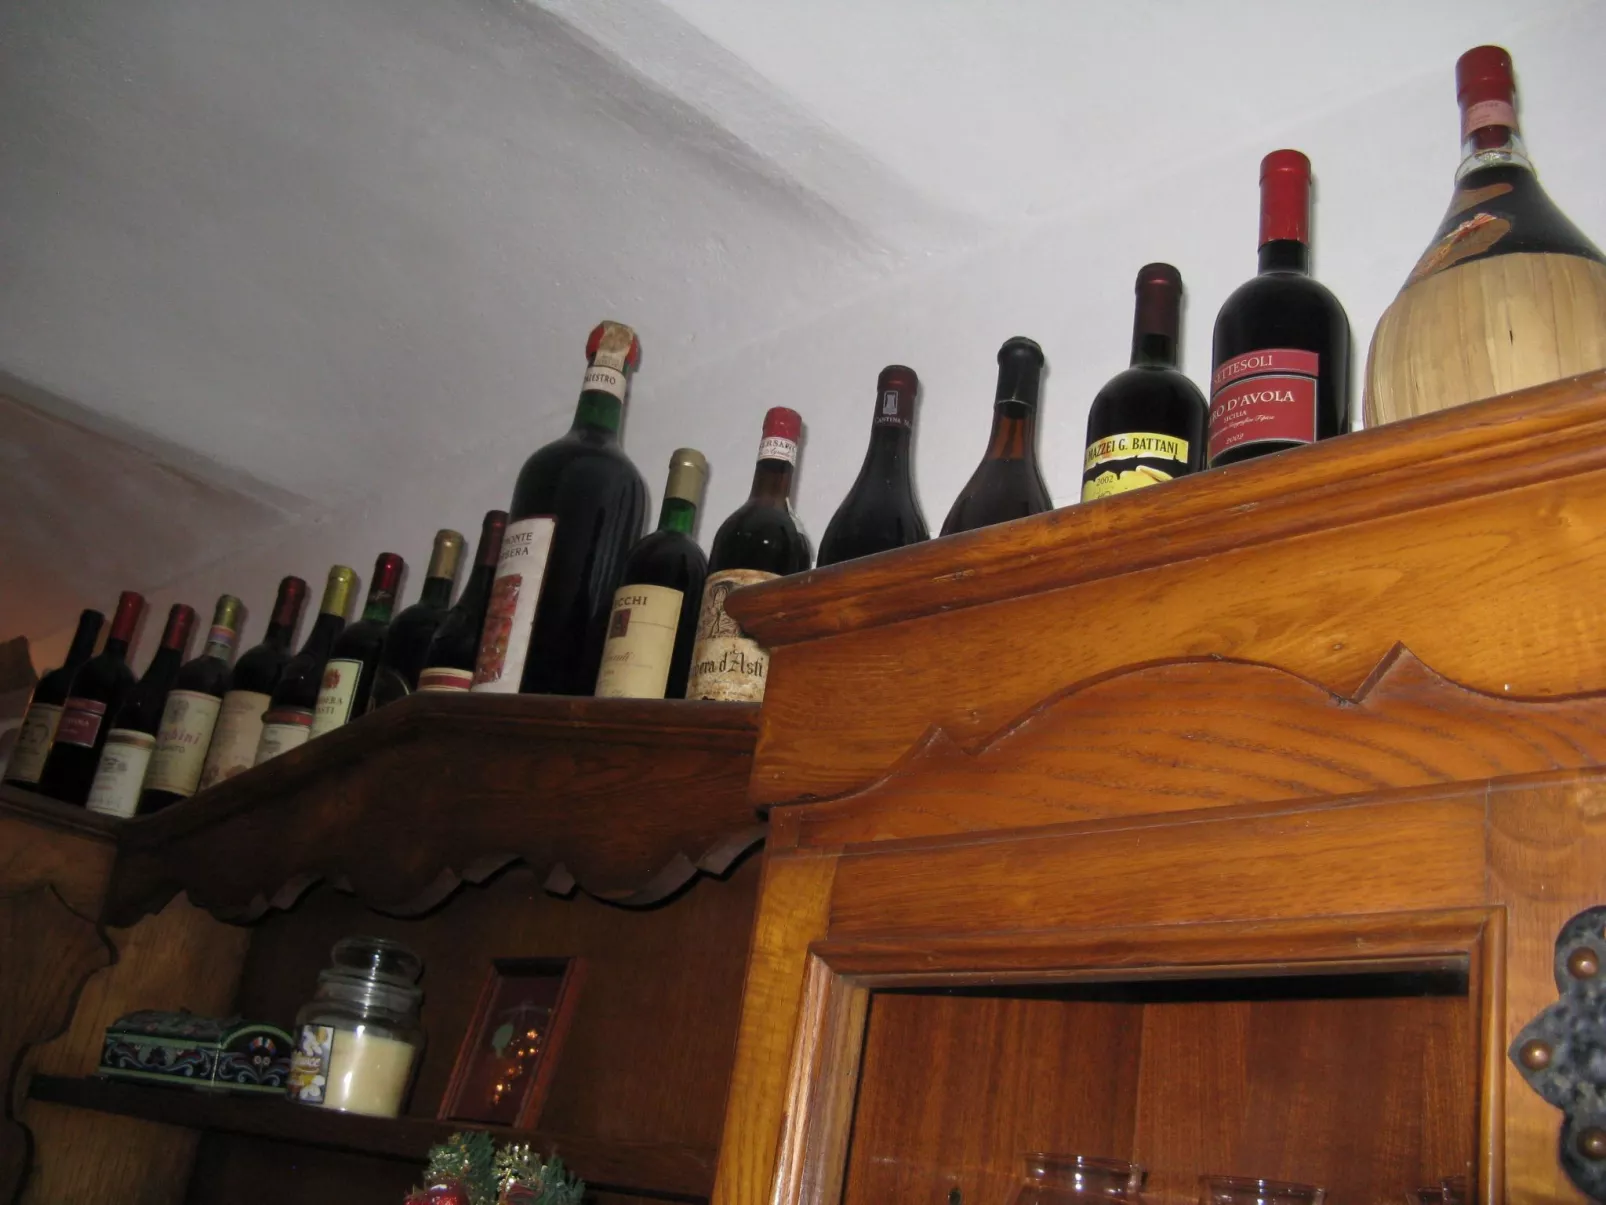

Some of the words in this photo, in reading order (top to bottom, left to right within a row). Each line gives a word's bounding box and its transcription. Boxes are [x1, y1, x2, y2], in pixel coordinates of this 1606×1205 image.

[1227, 390, 1295, 411] D'AVOLA
[1118, 439, 1128, 451] G.
[1132, 438, 1178, 456] BATTANI
[1096, 475, 1114, 486] 2002
[719, 643, 764, 677] d'Asti
